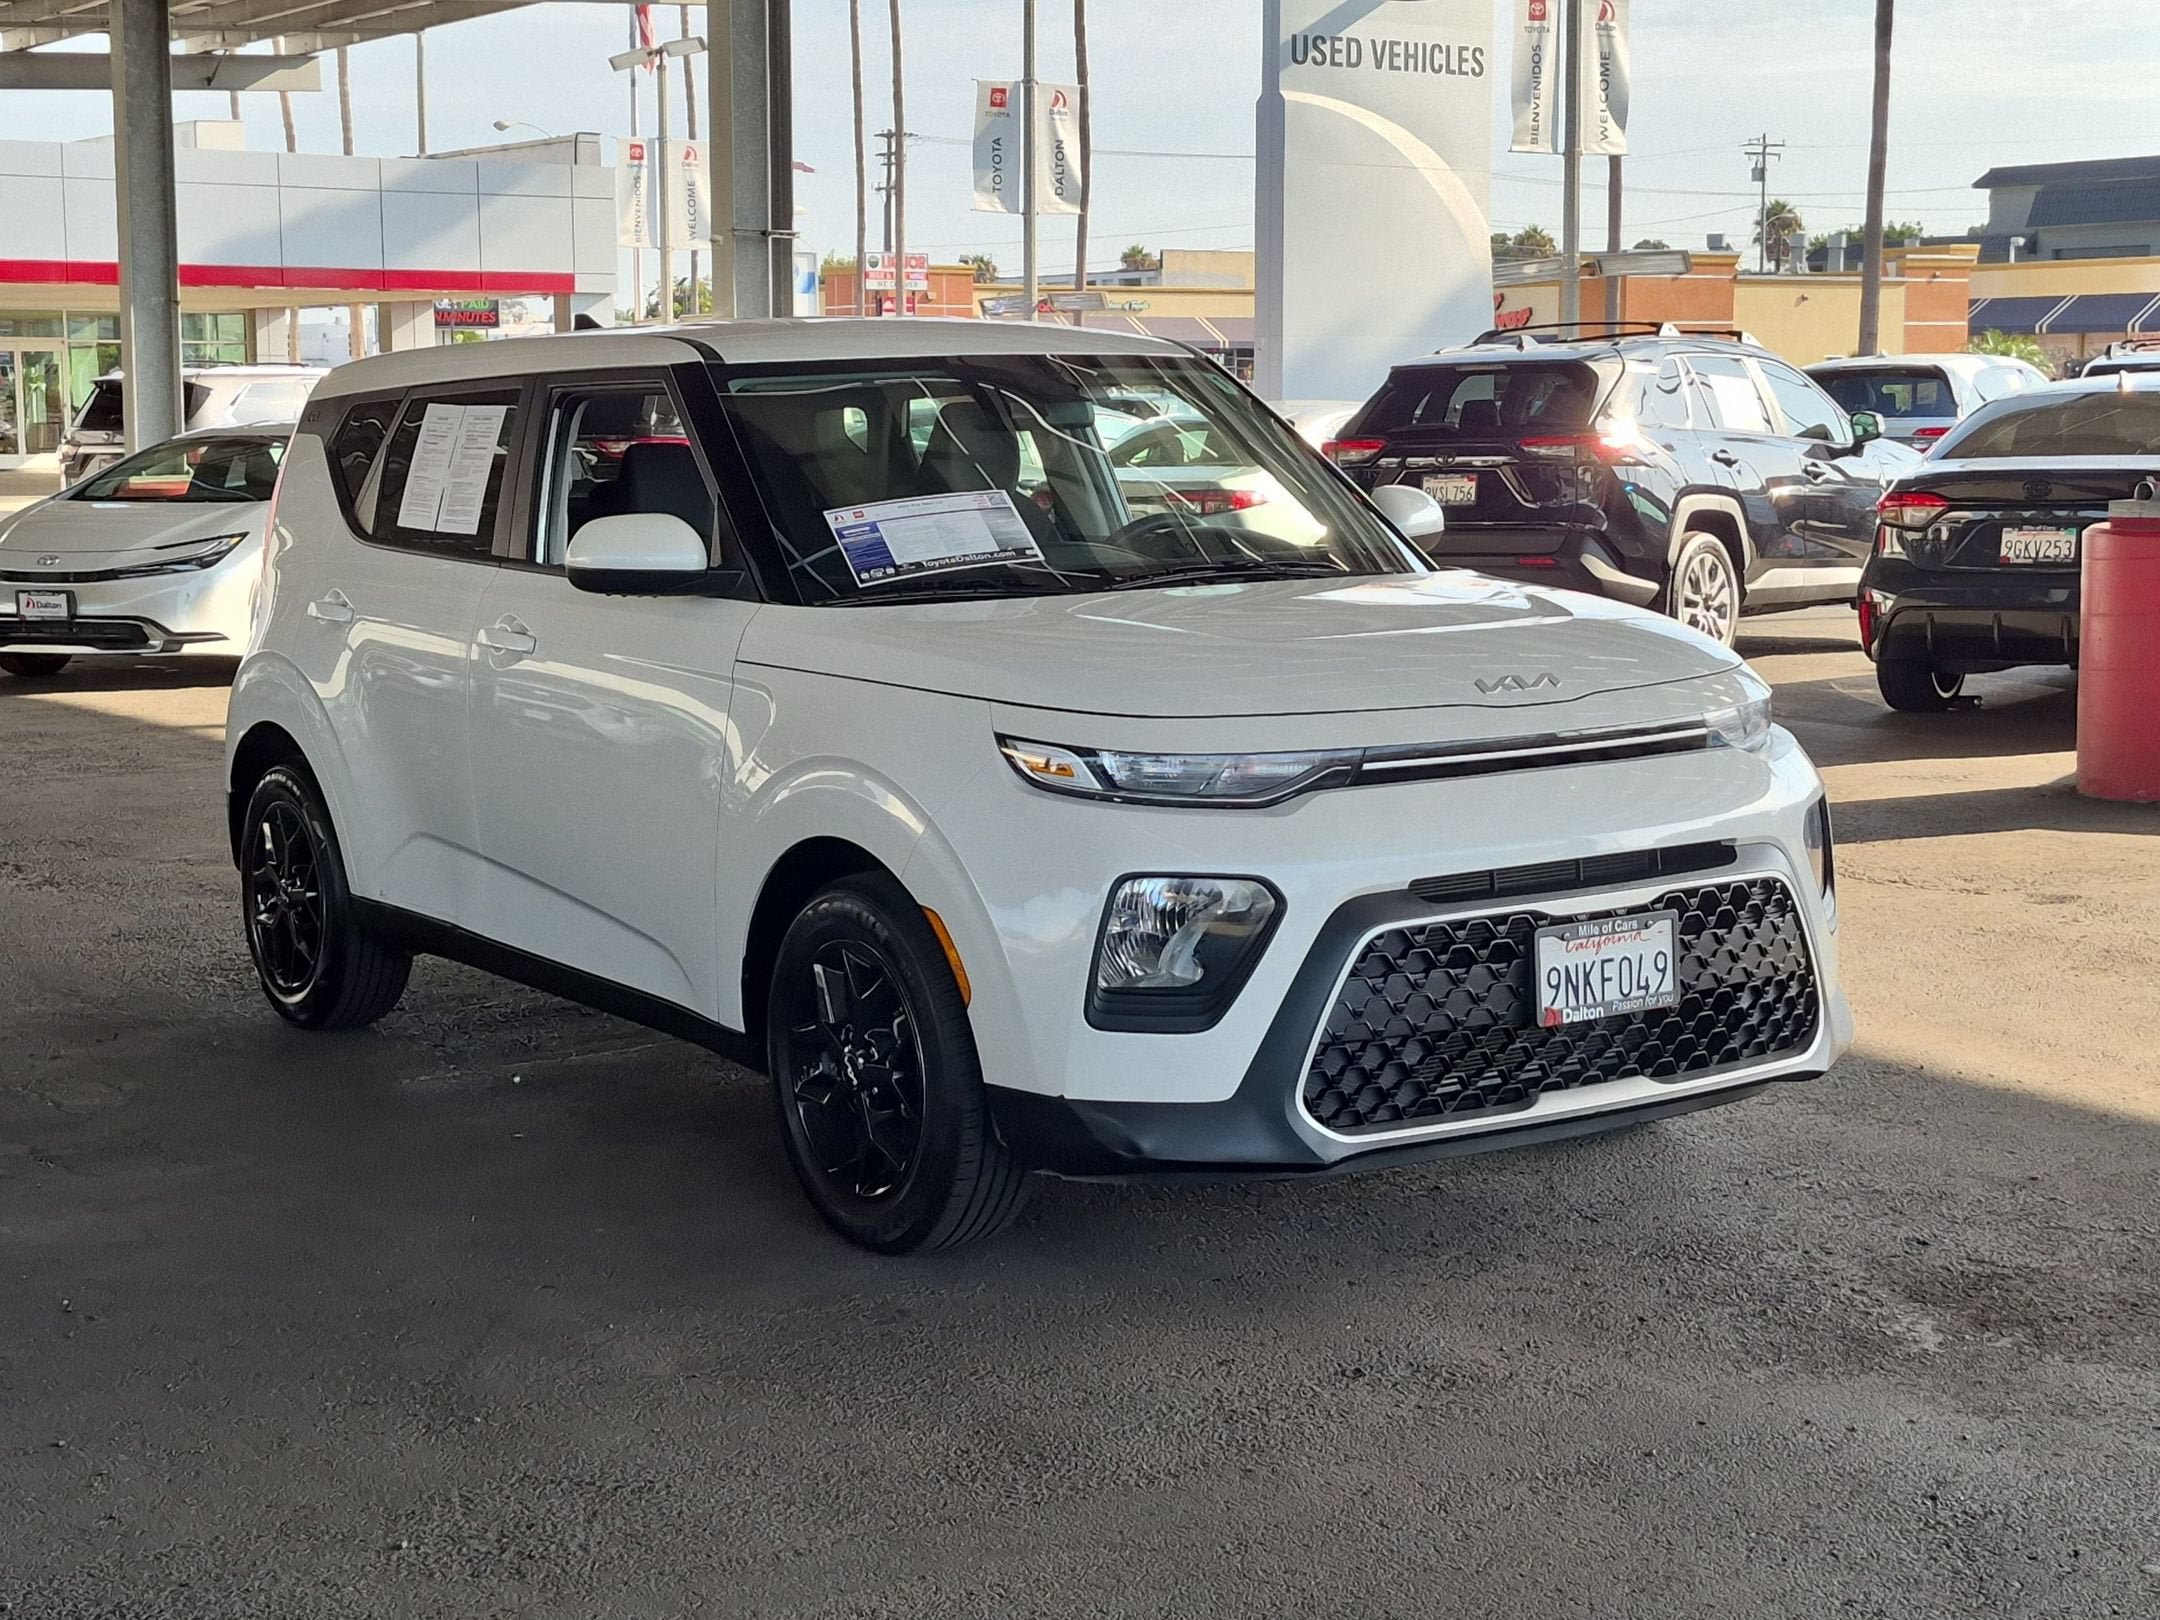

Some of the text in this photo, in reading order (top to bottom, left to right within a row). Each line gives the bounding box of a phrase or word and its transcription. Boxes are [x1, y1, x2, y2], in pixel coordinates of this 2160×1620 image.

[1523, 25, 1551, 34] TOYOTA
[1291, 33, 1484, 78] USED VEHICLES
[1530, 44, 1542, 145] BIENVENIDOS
[1599, 50, 1611, 142] WELCOME
[991, 137, 1003, 193] TOYOTA
[1054, 139, 1065, 196] DALTON
[633, 174, 642, 243] BIENVENIDOS
[687, 180, 697, 241] WELCOME
[2004, 540, 2072, 560] 9GKV253
[37, 601, 62, 609] Dalton
[1565, 931, 1651, 956] California
[1578, 919, 1639, 937] Mile of Cars
[1547, 950, 1668, 1007] 9NKF049
[1562, 993, 1675, 1024] Dalton Passion for you
